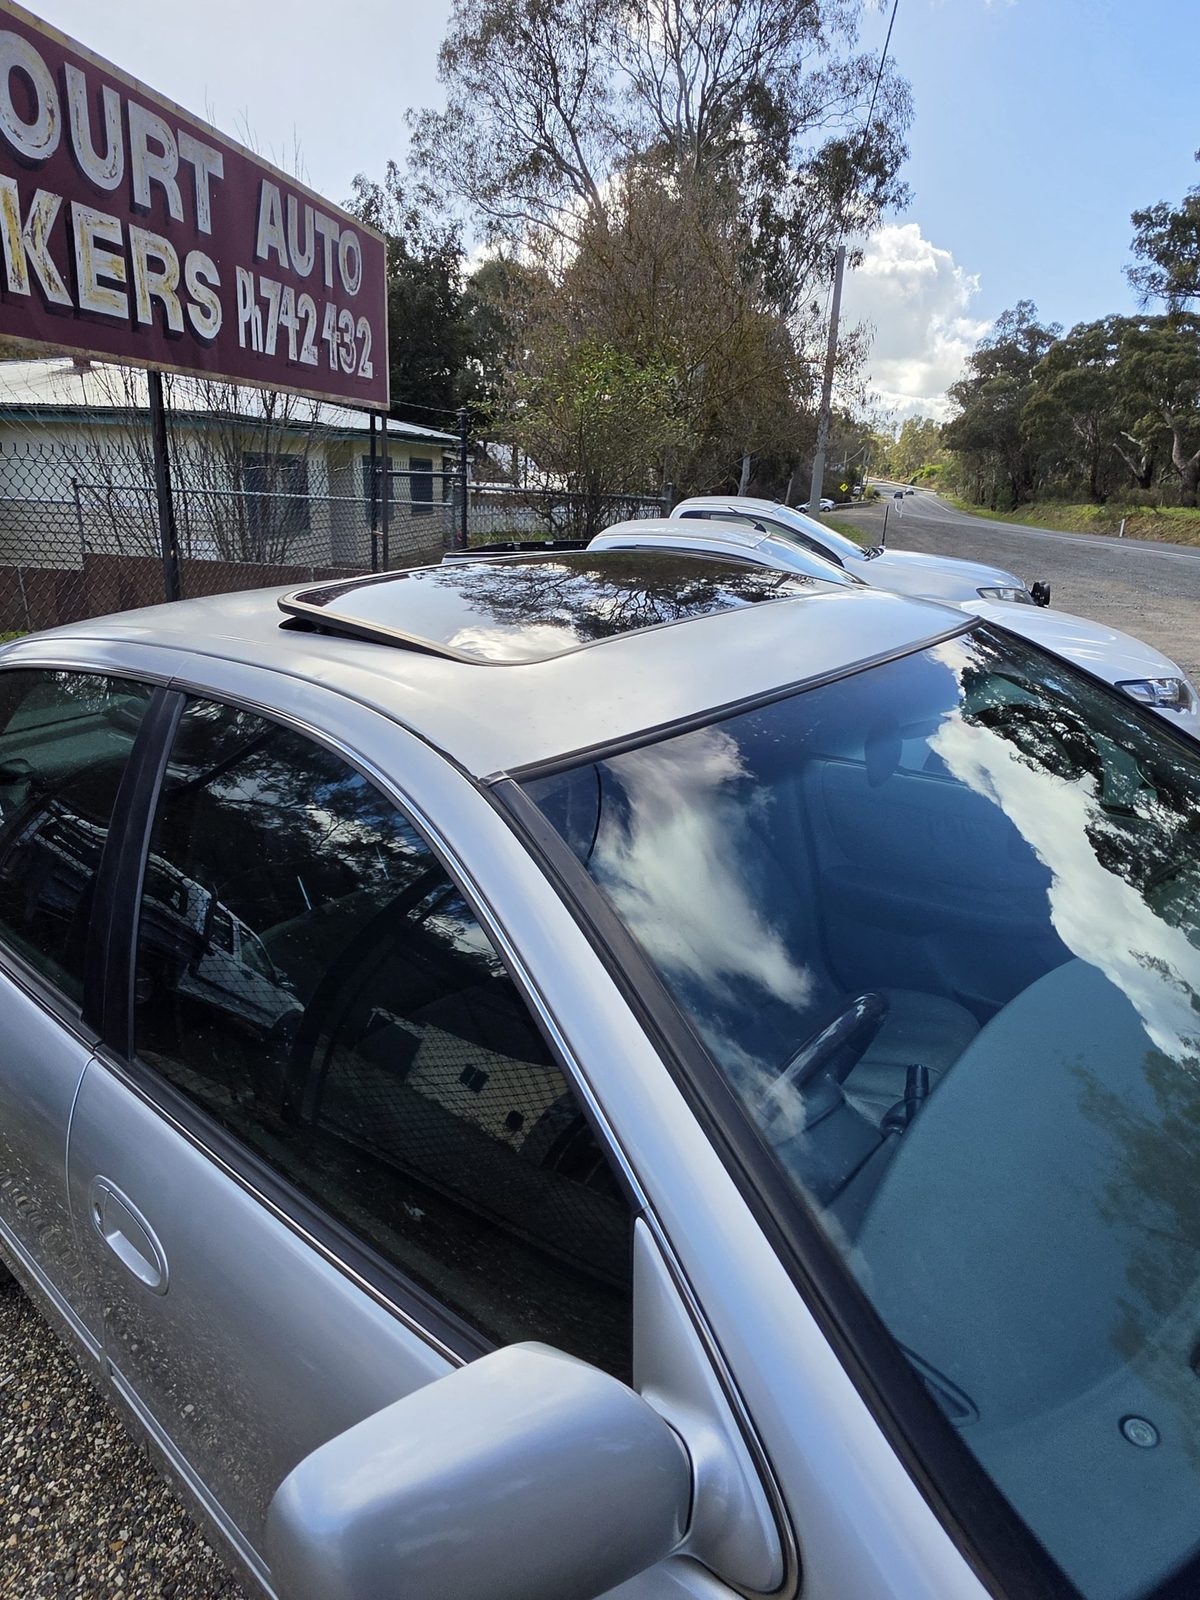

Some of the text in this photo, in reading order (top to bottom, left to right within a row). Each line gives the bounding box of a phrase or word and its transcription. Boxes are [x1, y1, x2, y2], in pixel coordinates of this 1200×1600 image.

[0, 30, 363, 296] OURT AUTO
[0, 174, 223, 340] KERS
